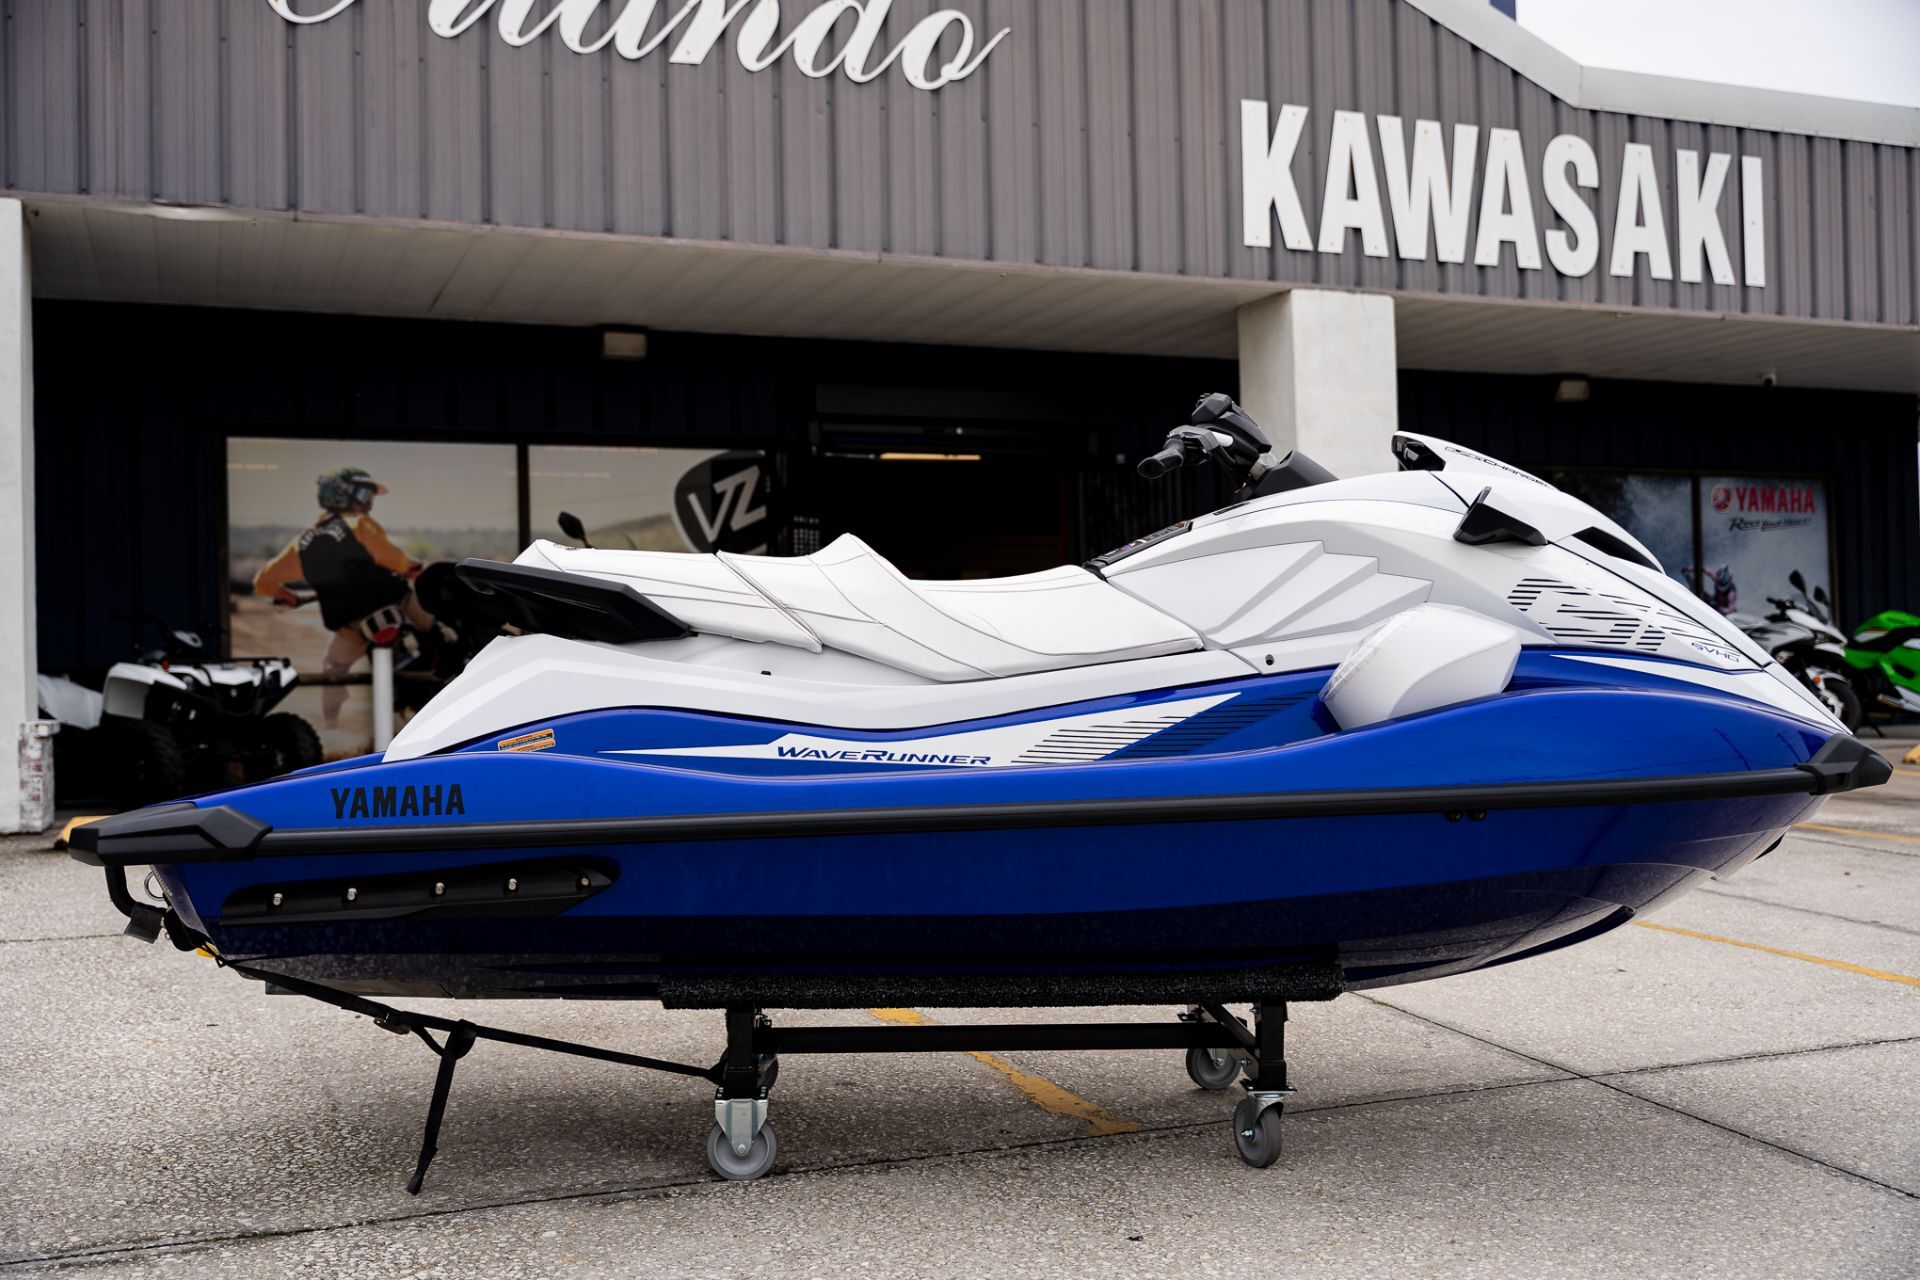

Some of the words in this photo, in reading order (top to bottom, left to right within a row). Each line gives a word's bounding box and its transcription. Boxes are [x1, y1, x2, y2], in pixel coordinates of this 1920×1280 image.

[1241, 99, 1765, 288] KAWASAKI
[1735, 486, 1816, 513] YAMAHA
[1691, 642, 1739, 662] SVHO
[777, 746, 992, 765] WAVERUNNER
[330, 784, 465, 819] YAMAHA
